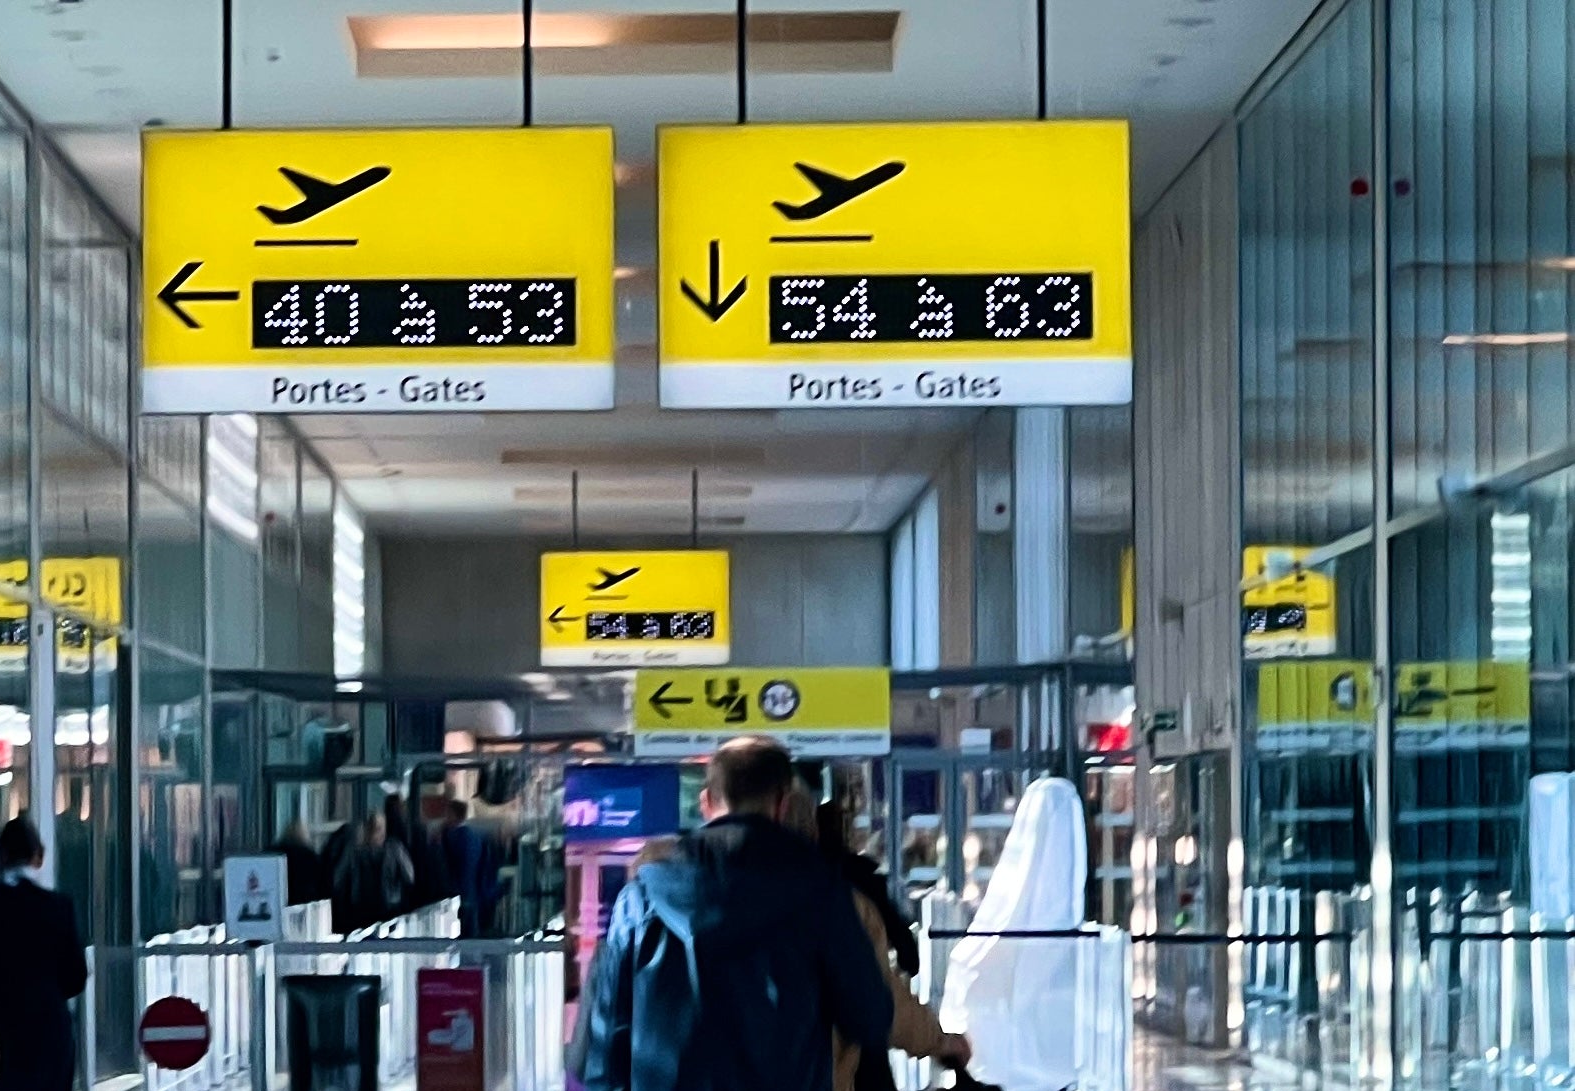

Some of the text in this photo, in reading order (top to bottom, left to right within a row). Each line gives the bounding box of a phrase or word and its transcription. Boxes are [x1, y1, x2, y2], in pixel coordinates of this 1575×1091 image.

[264, 282, 564, 345] 40 à 53
[781, 275, 1081, 339] 54 à 63
[271, 376, 366, 406] Portes
[398, 375, 487, 404] Gates
[788, 372, 883, 402] Portes
[915, 371, 1002, 400] Gates
